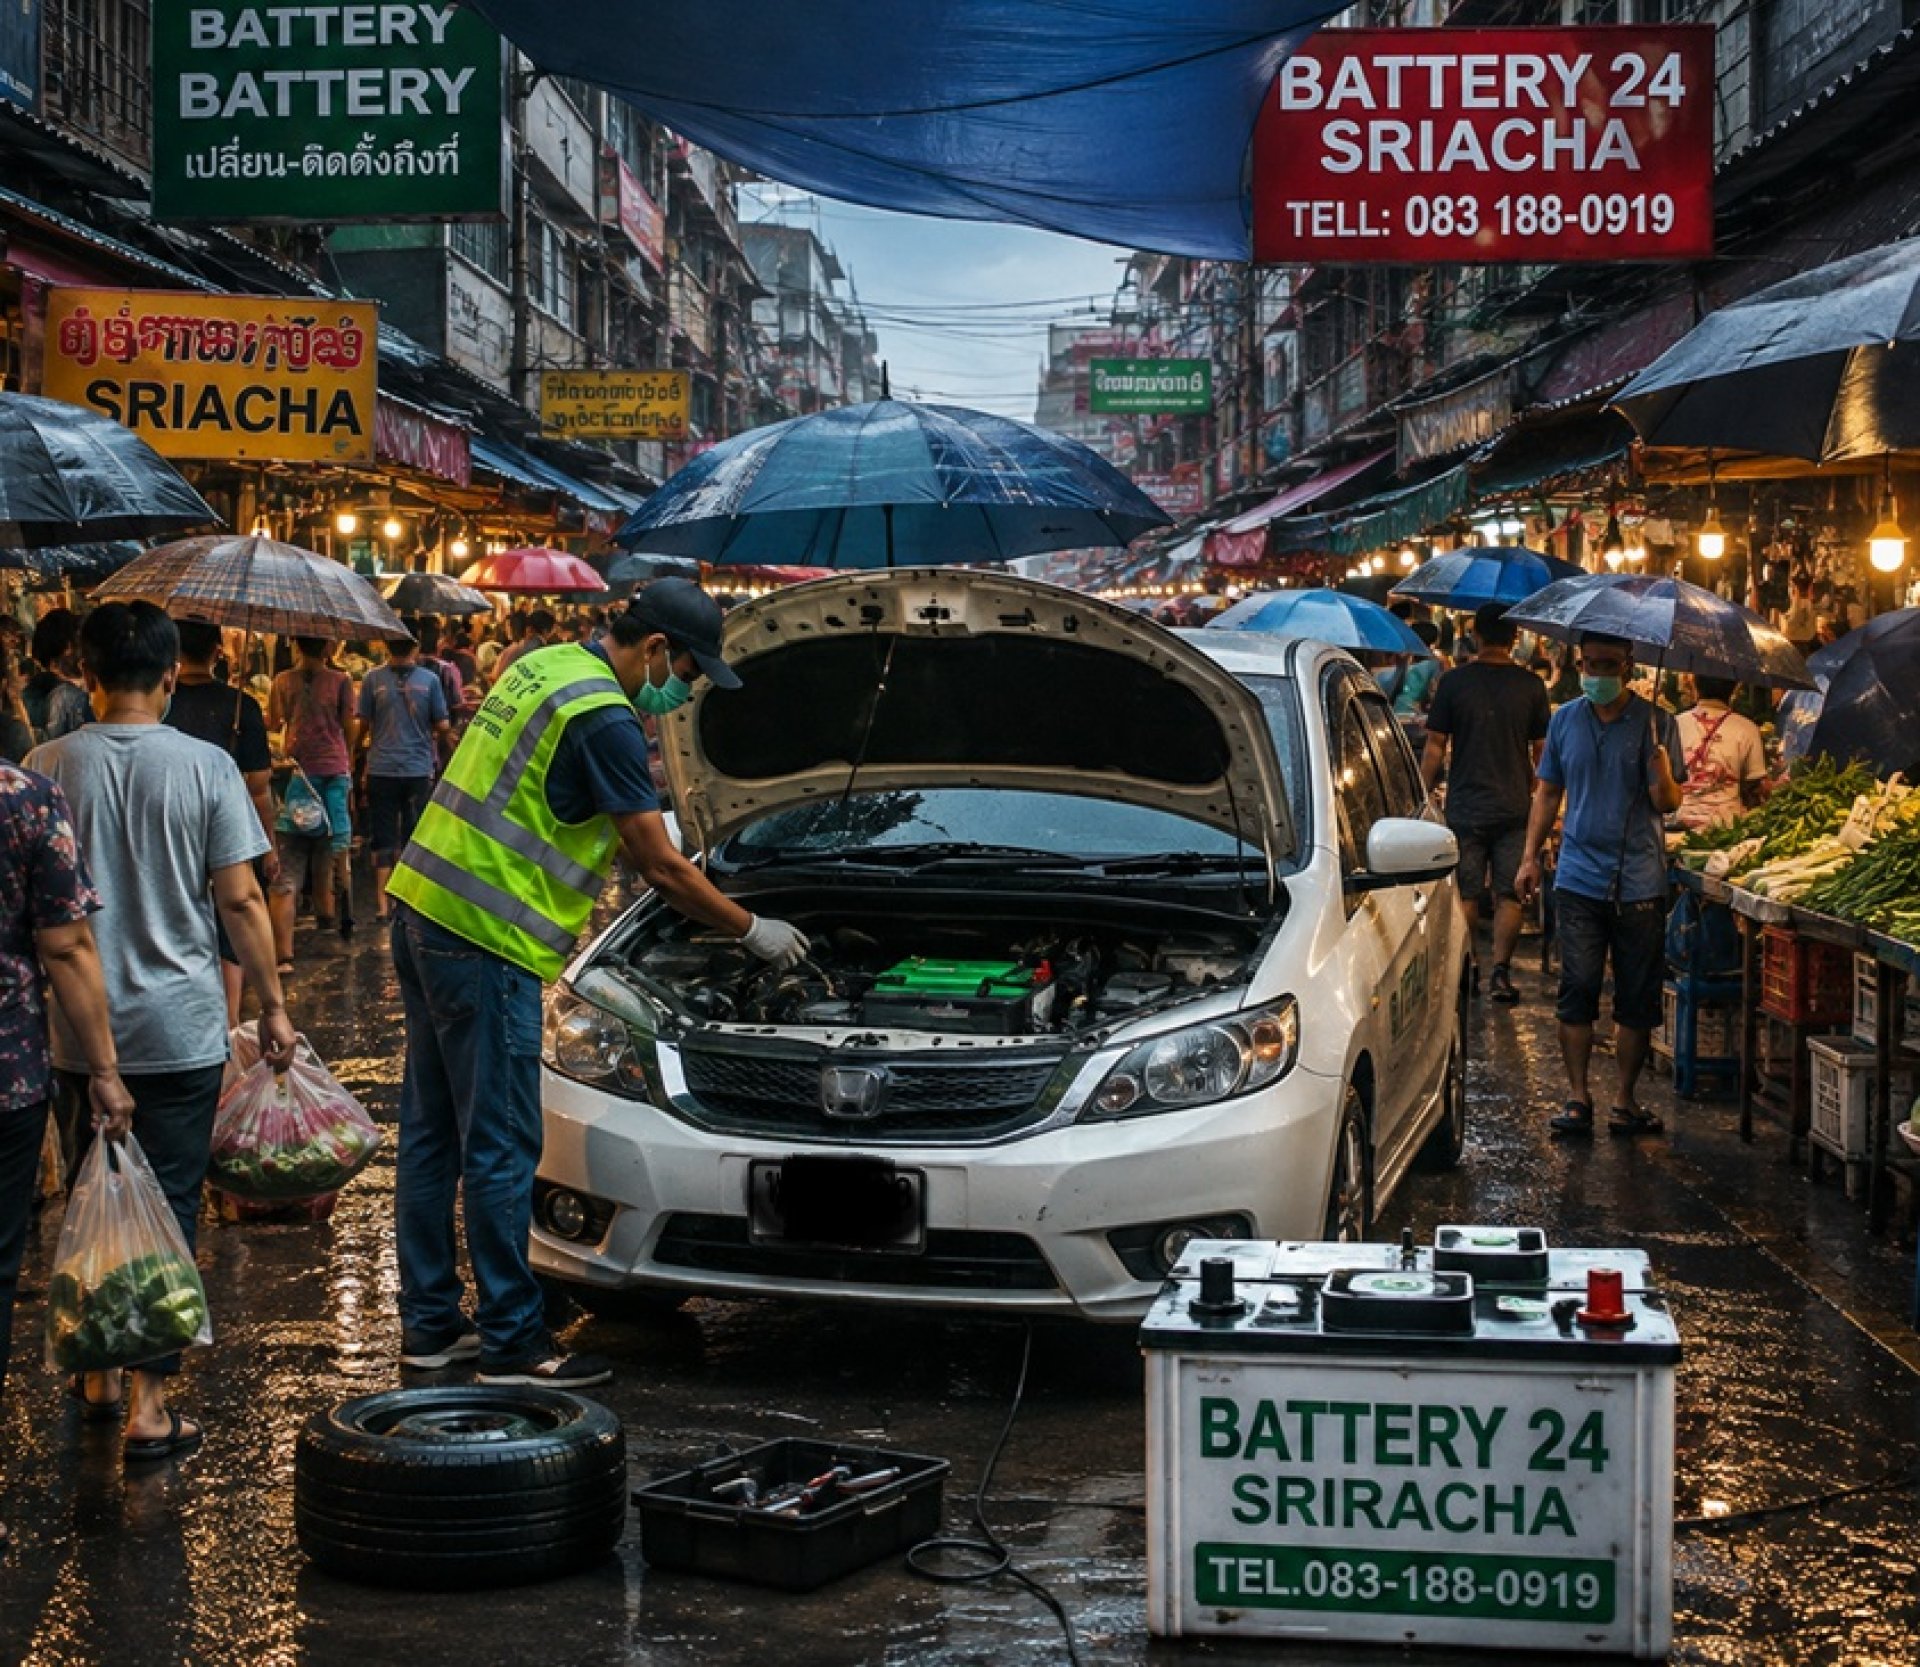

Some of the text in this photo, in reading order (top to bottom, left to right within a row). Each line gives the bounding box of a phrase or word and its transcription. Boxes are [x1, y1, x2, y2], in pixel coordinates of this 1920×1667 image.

[190, 4, 456, 49] BATTERY
[179, 67, 477, 119] BATTERY
[1280, 52, 1686, 110] BATTERY 24
[1320, 118, 1642, 173] SRIACHA
[1286, 193, 1676, 238] TELL: 083 188-0919
[85, 379, 363, 435] SRIACHA
[1200, 1396, 1610, 1474] BATTERY 24
[1231, 1473, 1578, 1538] SRIRACHA
[1208, 1556, 1602, 1610] TEL.083-188-0919
